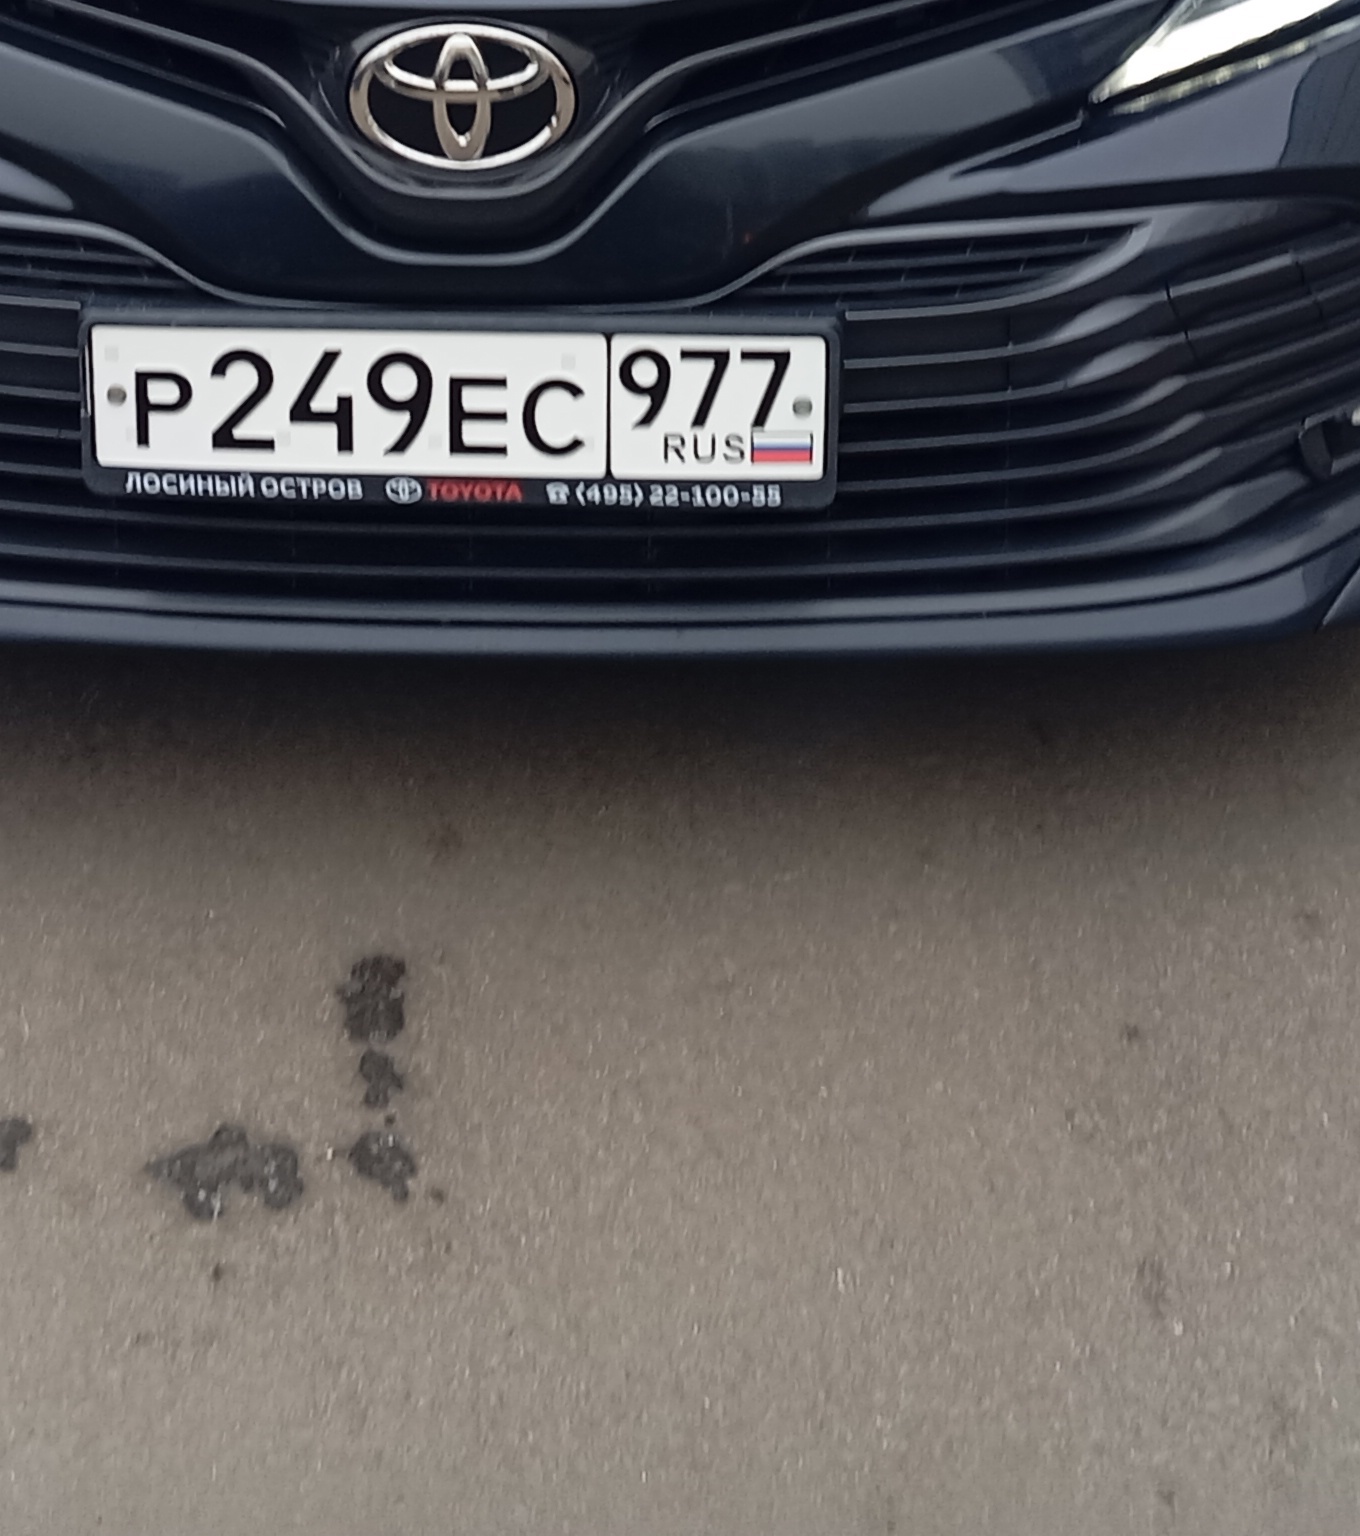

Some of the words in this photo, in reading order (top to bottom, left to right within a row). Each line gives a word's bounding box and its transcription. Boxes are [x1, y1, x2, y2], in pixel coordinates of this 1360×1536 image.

[134, 349, 586, 457] Р249ЕС
[619, 348, 791, 429] 977
[663, 432, 746, 465] RUS
[125, 470, 256, 499] ЛОСИНЫЙ
[260, 475, 364, 501] ОСТРОВ
[426, 481, 524, 503] TOYOTA
[575, 481, 644, 507] (495)
